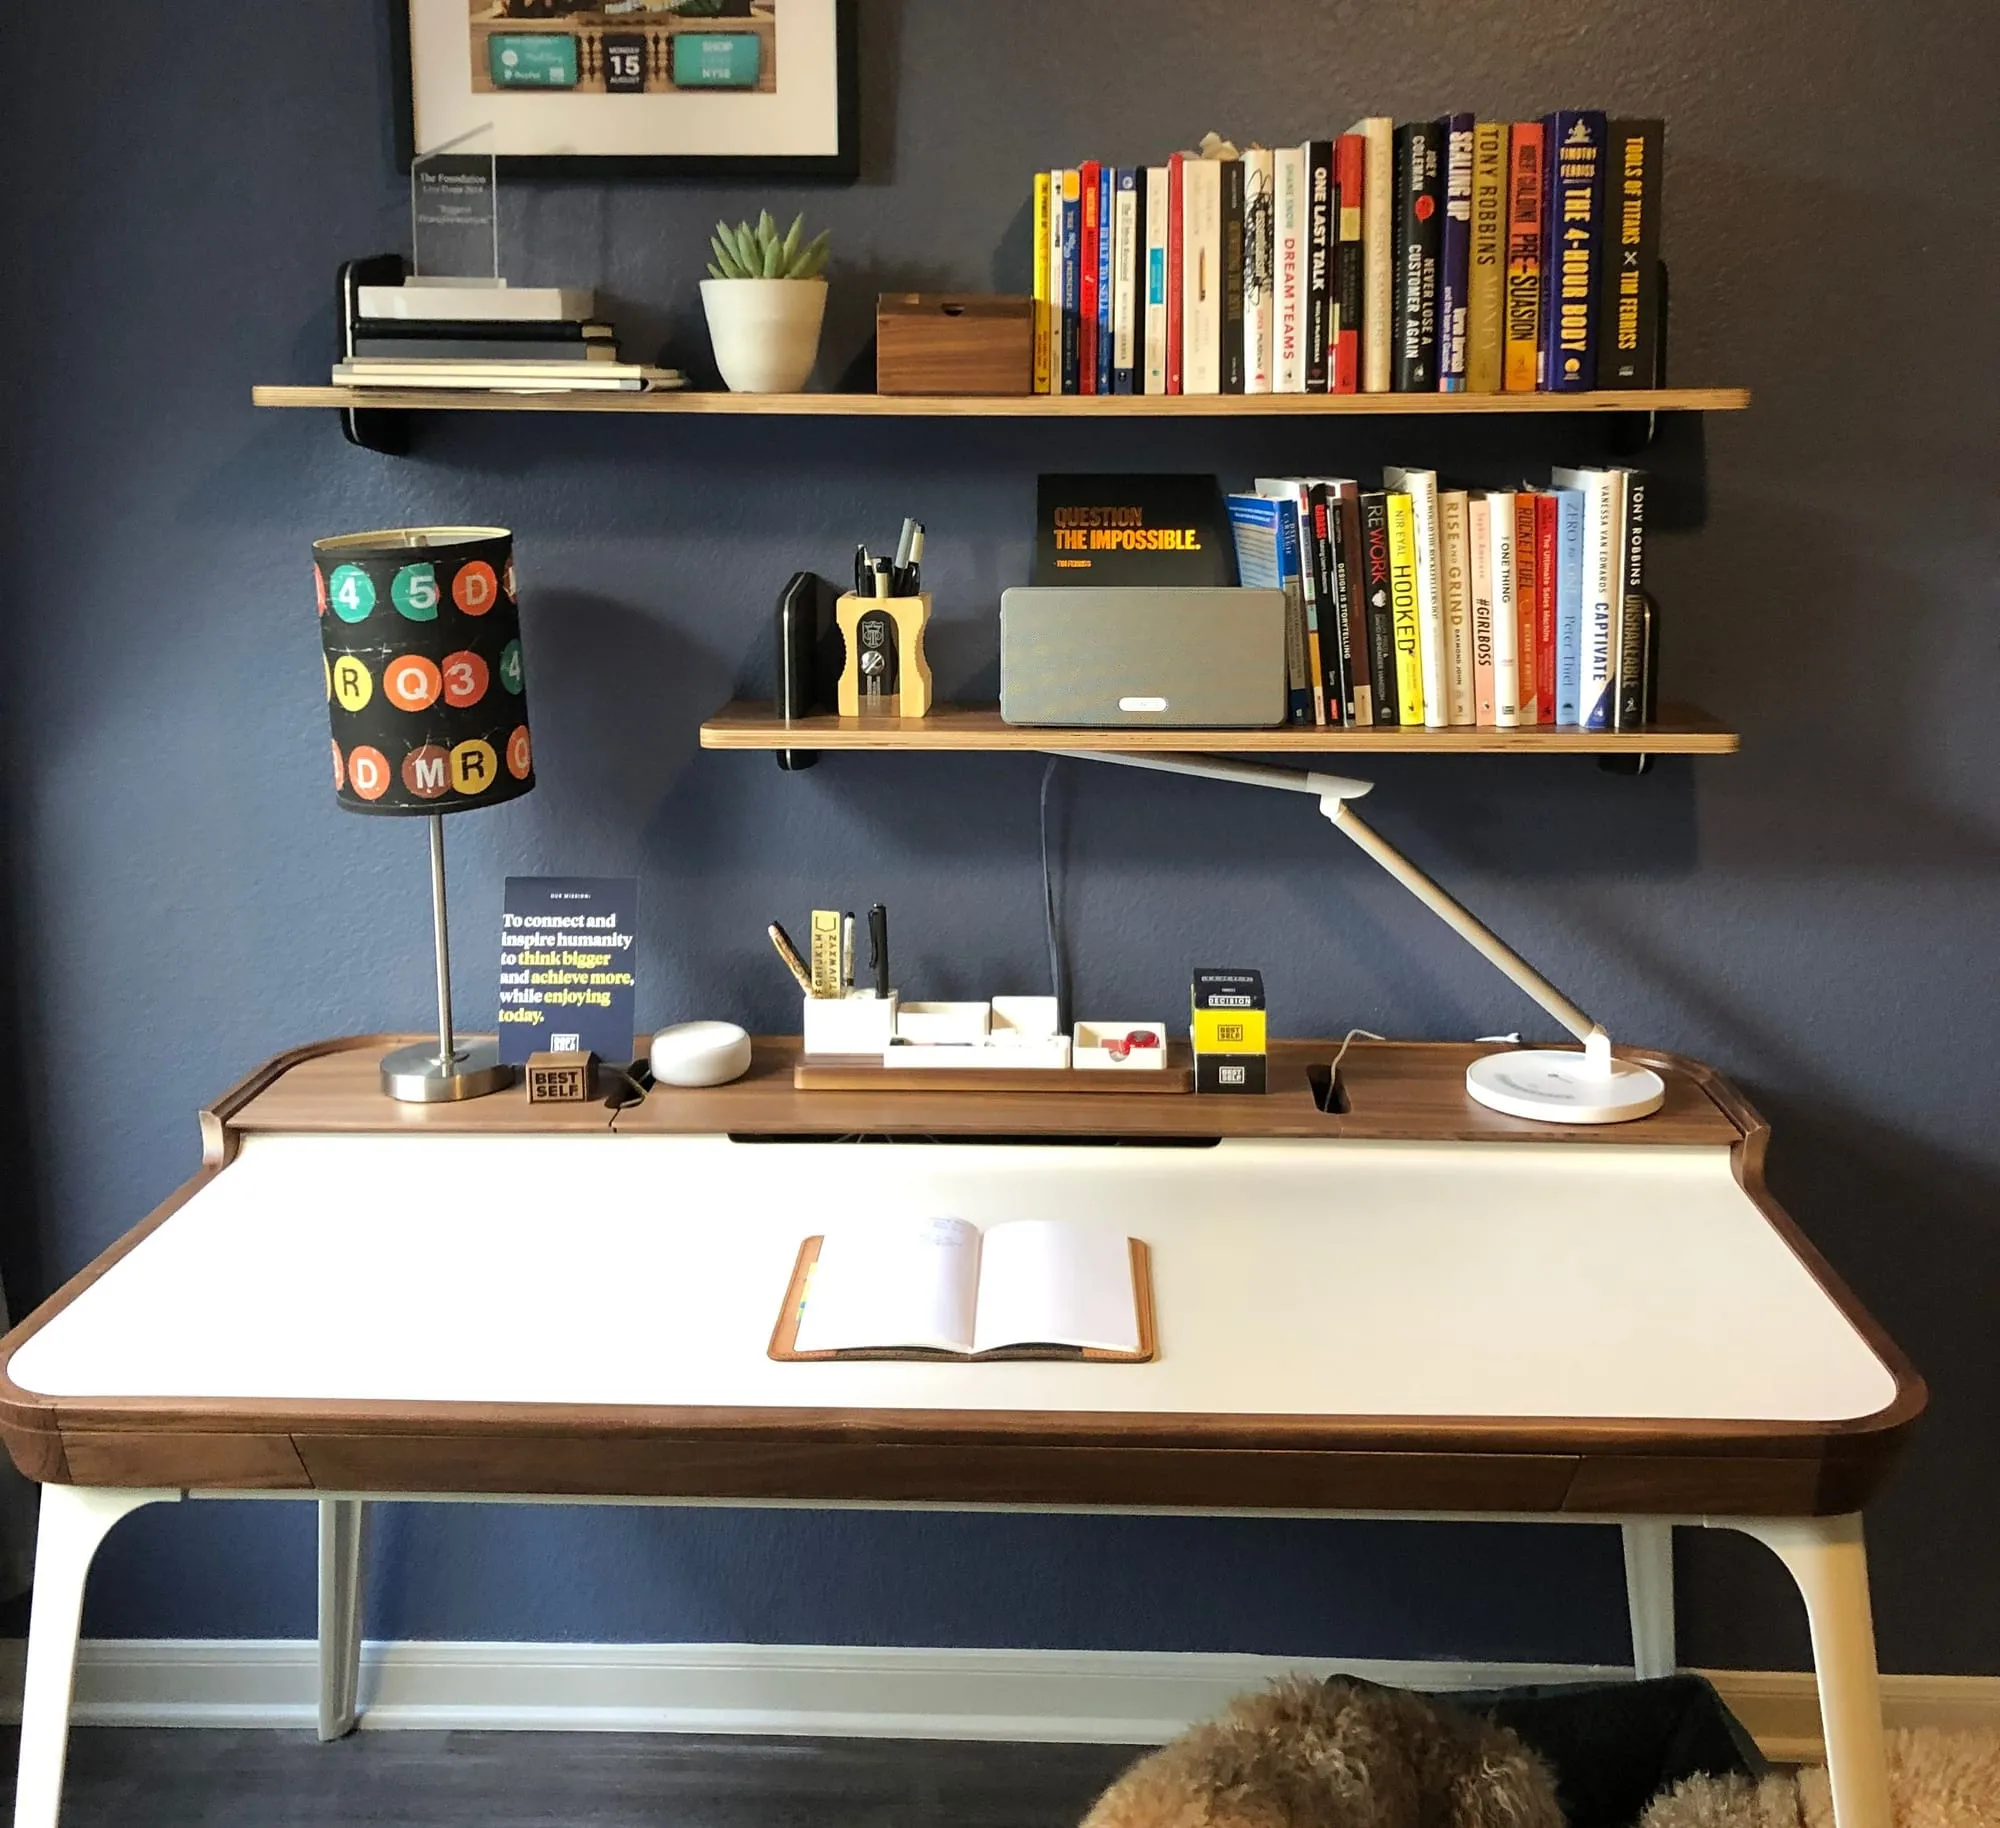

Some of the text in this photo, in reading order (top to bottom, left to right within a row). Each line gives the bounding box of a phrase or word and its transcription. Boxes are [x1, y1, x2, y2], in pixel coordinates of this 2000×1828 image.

[609, 55, 641, 76] 15
[1411, 135, 1426, 191] COLEMAN
[1446, 131, 1473, 221] SCALING UP
[1620, 136, 1645, 245] TOOLS OF TITANS
[1477, 130, 1498, 266] TONY ROBBINS
[1311, 167, 1327, 291] ONE LAST TALK
[1509, 233, 1540, 342] PRE-SUASION
[1559, 187, 1592, 352] THE 4-HOUR BODY
[1282, 238, 1296, 360] DREAM TEAMS
[1405, 244, 1421, 359] CUSTOMER AGAIN
[1421, 258, 1435, 345] NEVER LOSE A
[1617, 271, 1640, 350] TIM FERRISS
[1053, 529, 1202, 550] THE IMPOSSIBLE.
[1054, 506, 1143, 528] QUESTION
[1314, 504, 1328, 540] BADASS
[1367, 504, 1388, 586] REWORK
[1394, 510, 1406, 557] NIR EYAL
[1543, 533, 1552, 549] The
[1565, 503, 1579, 542] ZERO
[1598, 485, 1611, 594] VANESSA VAN EDWARDS
[1630, 485, 1644, 586] TONY ROBBINS
[1447, 502, 1463, 625] RISE AND GRIND
[1501, 543, 1511, 604] ONE THING
[1518, 507, 1534, 591] ROCKET FUEL
[1542, 550, 1552, 585] Ultimate
[338, 574, 488, 610] 4 5 D
[1337, 563, 1352, 660] DESIGN IS STORYTELLING
[1393, 565, 1416, 651] HOOKED
[1543, 587, 1552, 608] Sales
[1476, 599, 1491, 667] #GIRLBOSS
[1542, 610, 1551, 641] Machine
[1562, 616, 1575, 687] Peter Thiel
[1593, 602, 1609, 681] CAPTIVATE
[1622, 594, 1642, 689] UNSHAKEABLE
[342, 651, 521, 701] R Q 3 4
[1454, 628, 1463, 686] DAYMOND JOHN
[357, 750, 484, 789] D M R
[501, 931, 634, 950] inspire humanity
[502, 913, 616, 928] To connect and
[500, 950, 612, 969] to think bigger
[500, 969, 635, 987] and achieve more,
[498, 1007, 545, 1026] today.
[499, 988, 612, 1007] while enjoying
[534, 1071, 579, 1085] BEST
[536, 1084, 579, 1097] SELF
